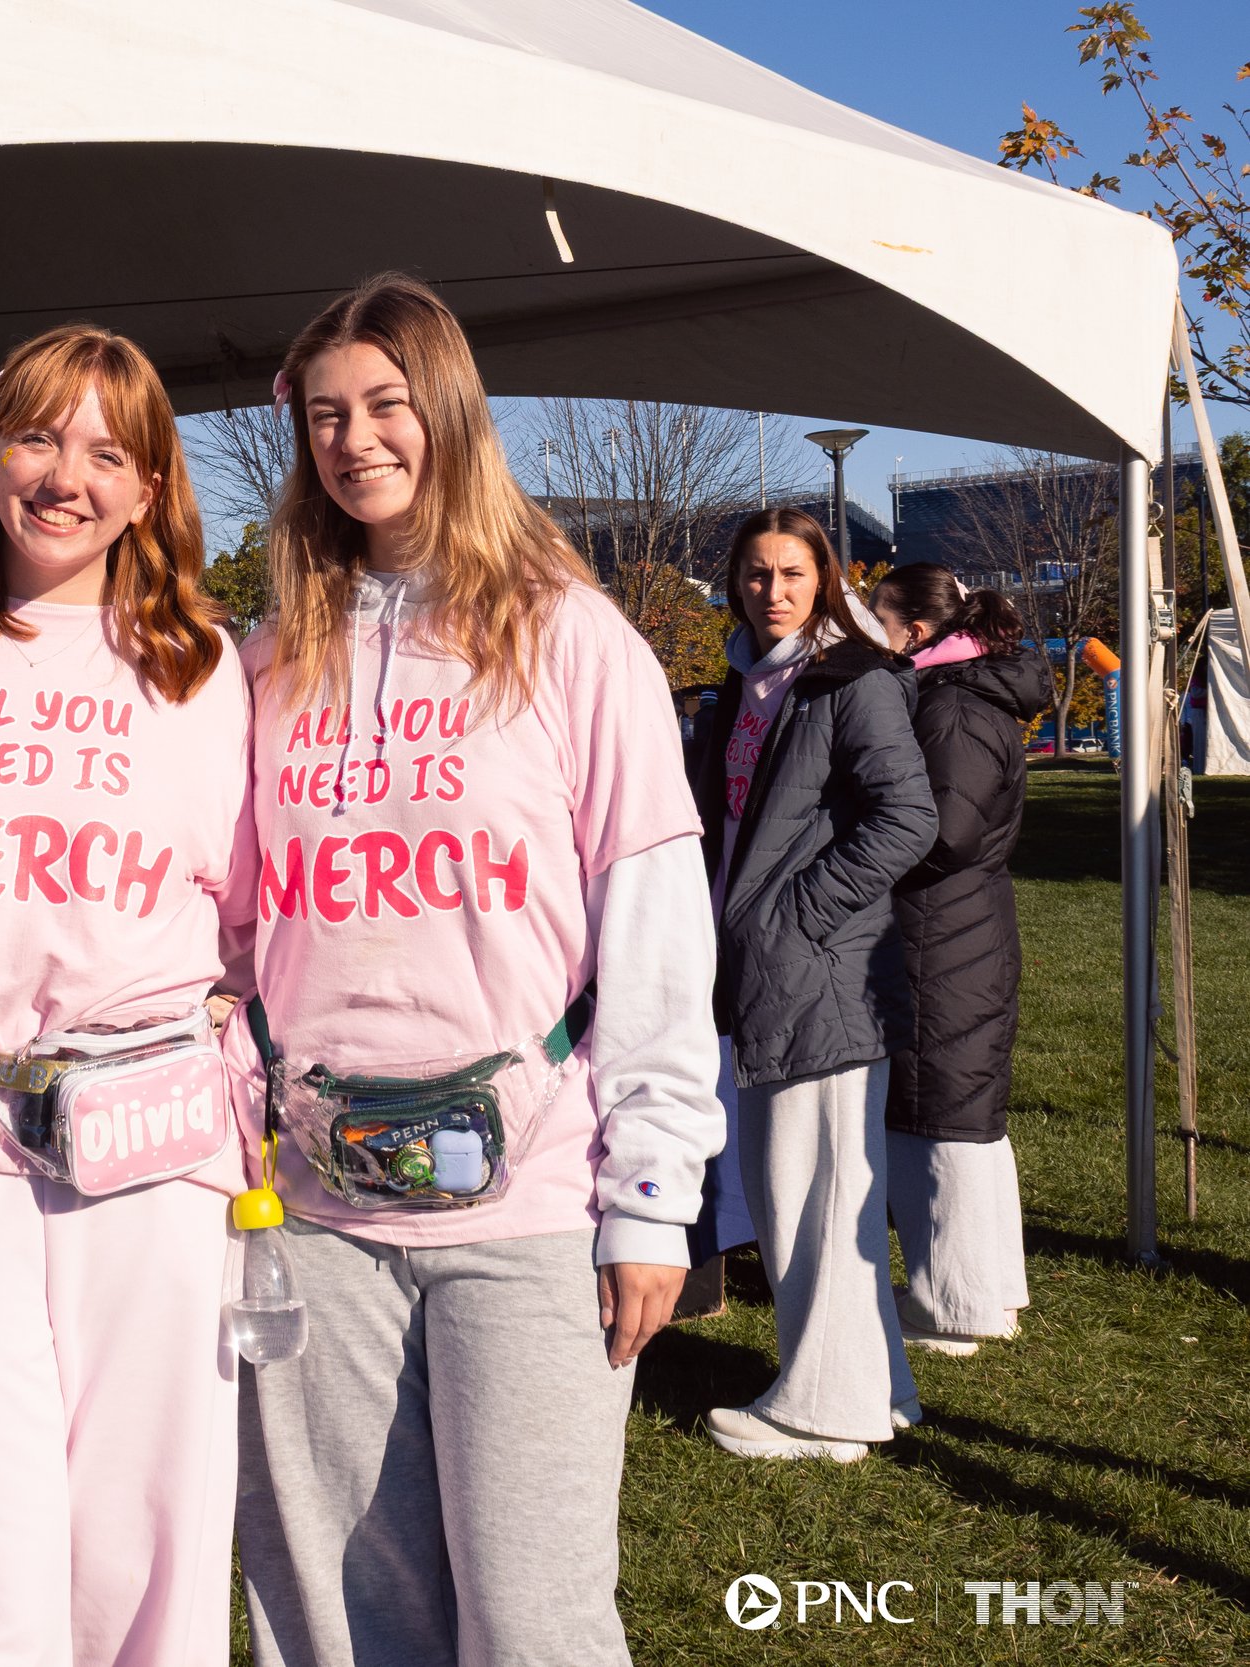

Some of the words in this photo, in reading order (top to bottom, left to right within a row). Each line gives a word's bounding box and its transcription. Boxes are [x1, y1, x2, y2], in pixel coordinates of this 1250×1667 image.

[30, 690, 134, 738] YOU
[73, 747, 131, 796] IS
[278, 758, 392, 808] NEED
[409, 753, 466, 802] IS
[258, 829, 529, 923] MERCH
[80, 1084, 214, 1163] Olivia
[391, 1118, 440, 1142] PENN
